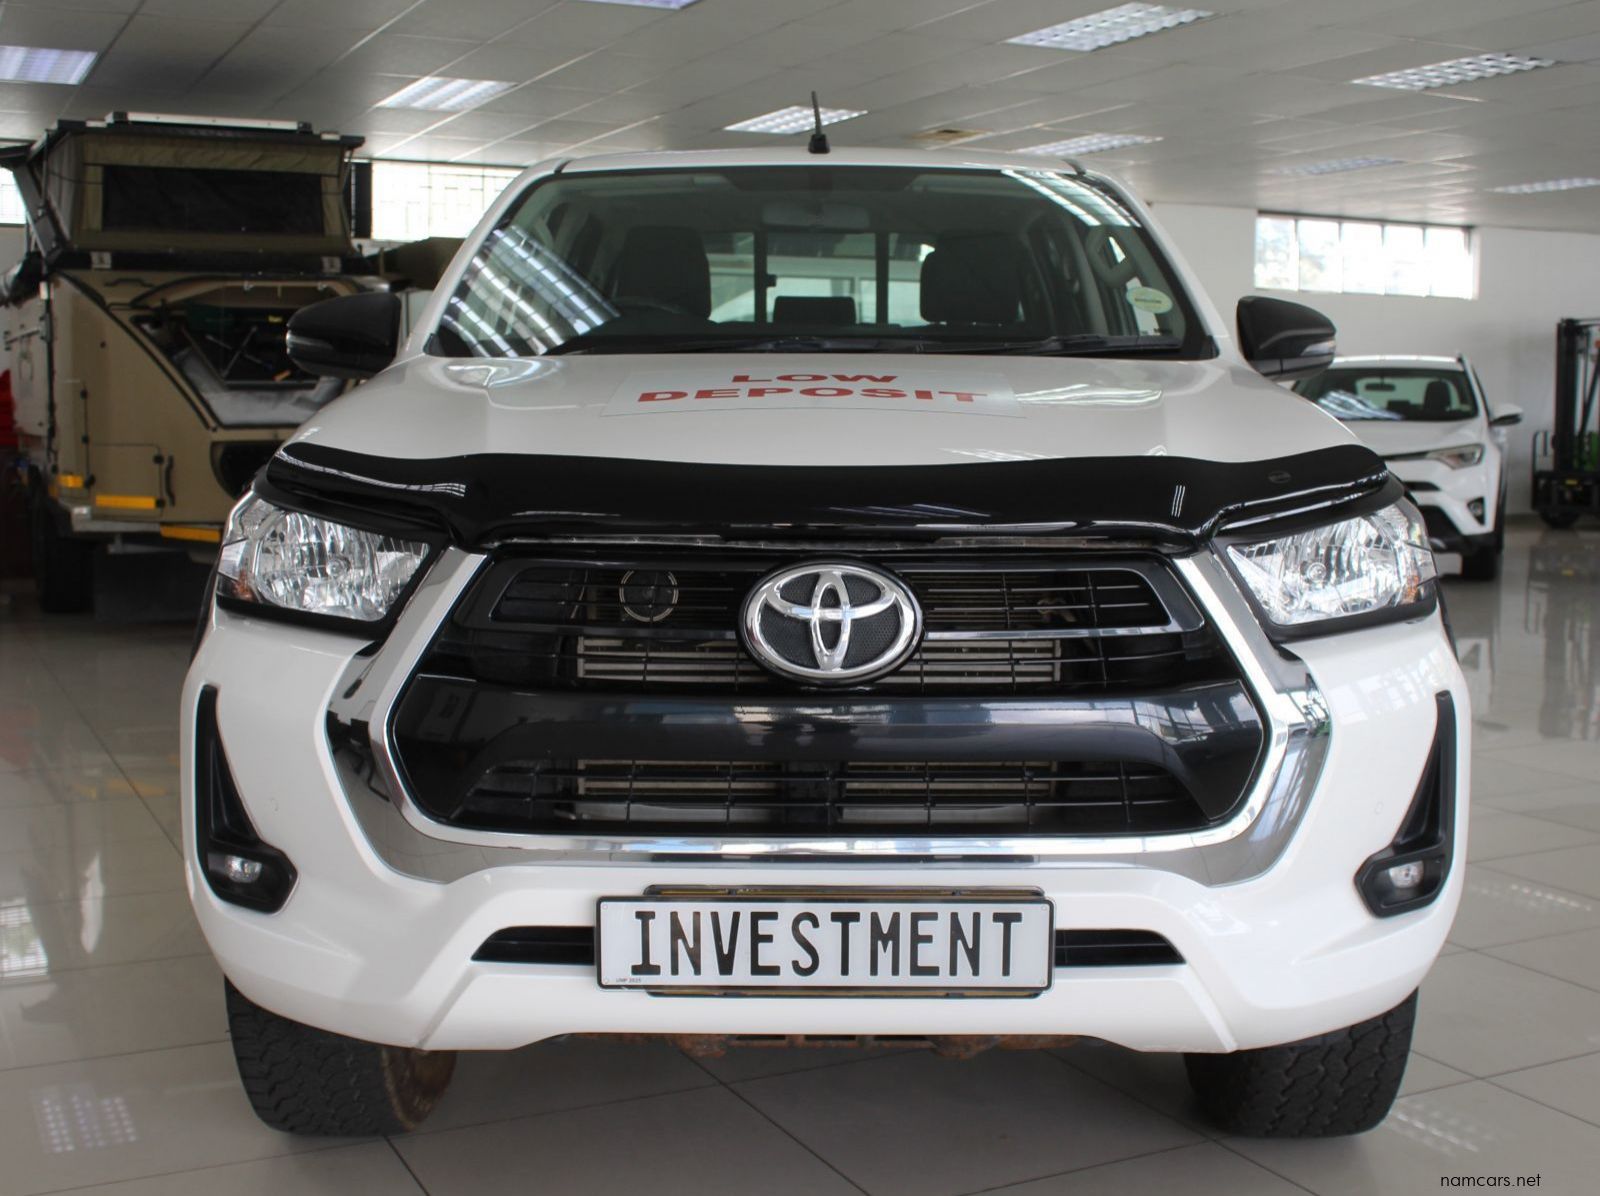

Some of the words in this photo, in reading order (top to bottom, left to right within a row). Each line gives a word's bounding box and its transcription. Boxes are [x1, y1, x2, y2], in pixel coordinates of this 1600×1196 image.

[732, 374, 898, 383] LOW
[637, 387, 989, 403] DEPOSIT
[631, 910, 1023, 977] INVESTMENT
